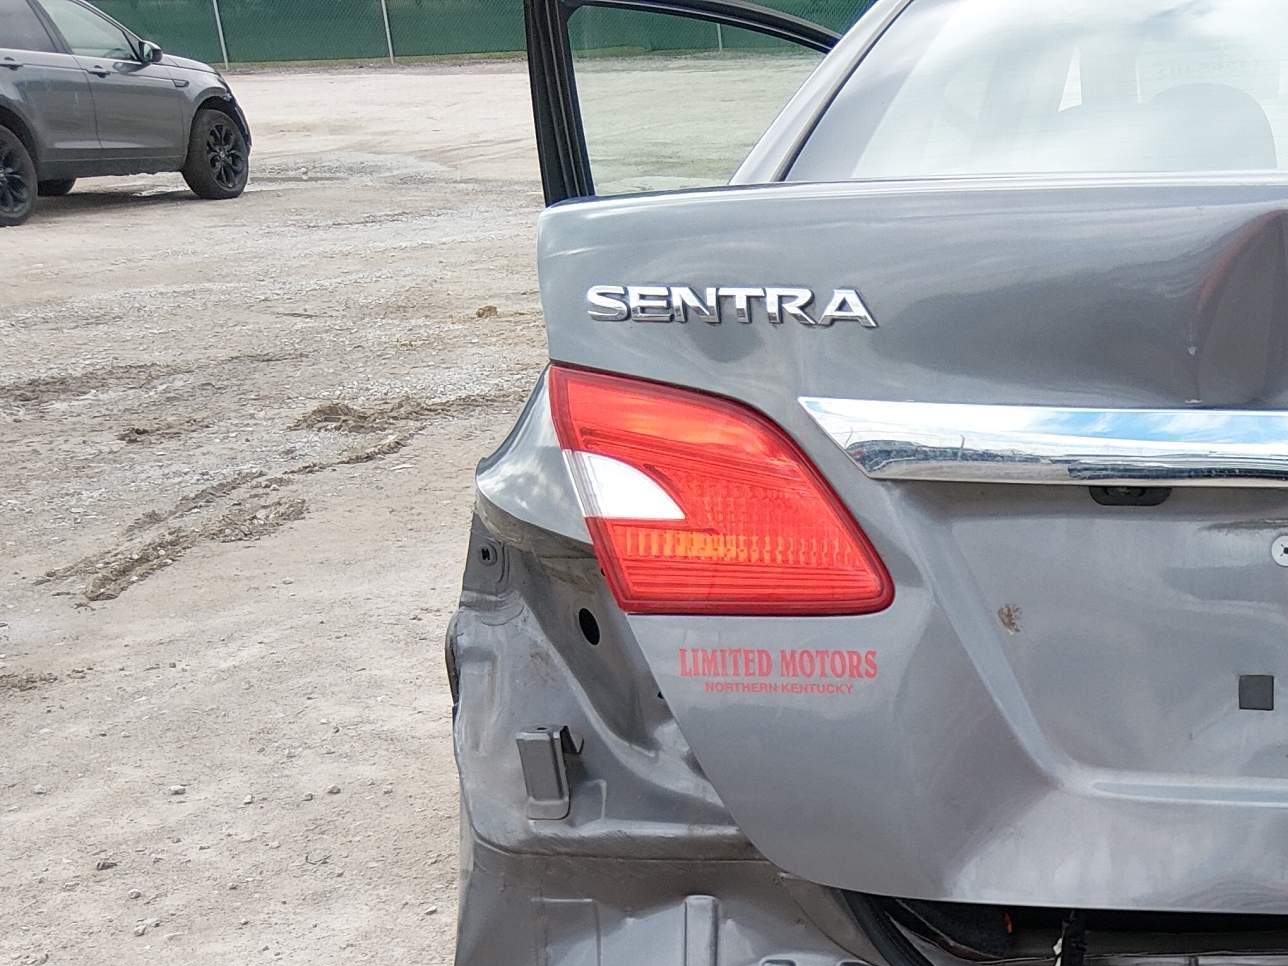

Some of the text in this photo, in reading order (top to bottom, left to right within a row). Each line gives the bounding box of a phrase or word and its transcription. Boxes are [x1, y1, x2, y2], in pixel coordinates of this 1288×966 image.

[586, 285, 879, 328] SENTRA
[679, 648, 879, 679] LIMITED MOTORS
[704, 682, 854, 694] NORTHERN KENTUCKY
